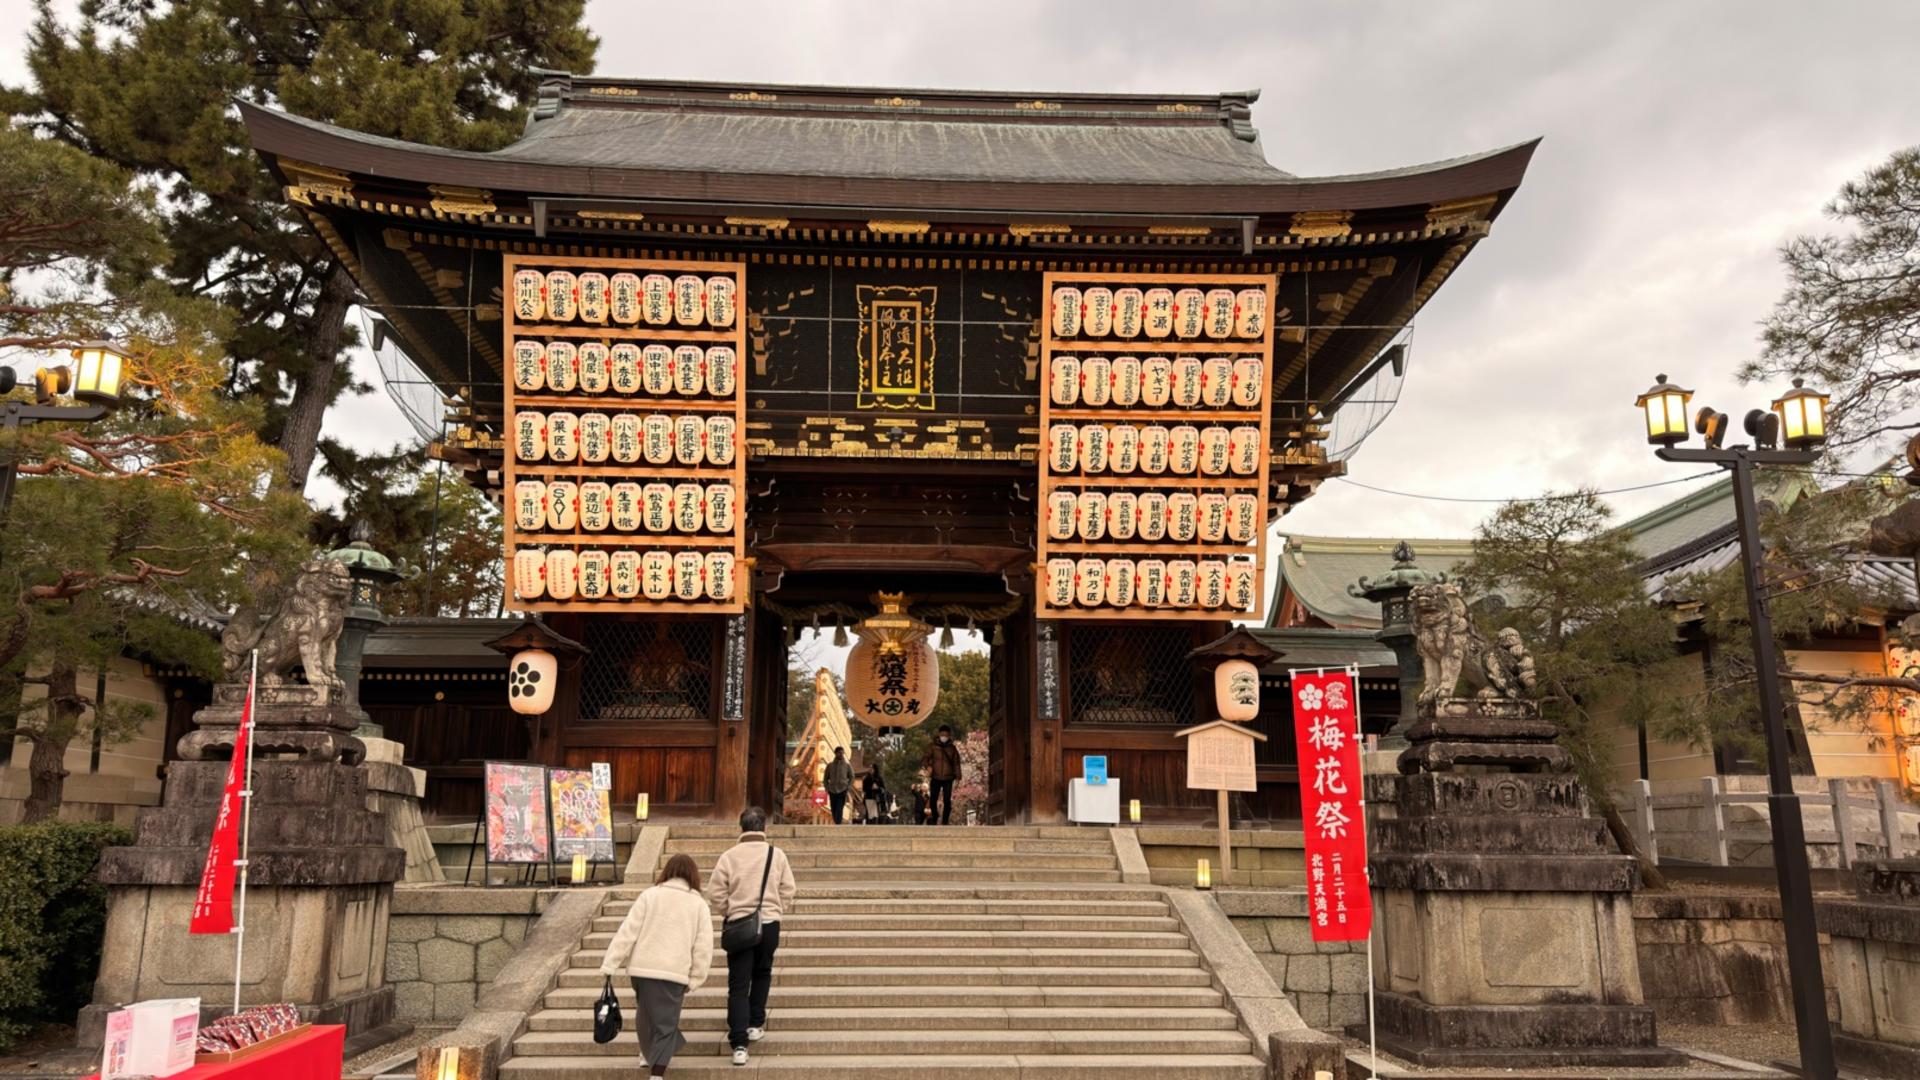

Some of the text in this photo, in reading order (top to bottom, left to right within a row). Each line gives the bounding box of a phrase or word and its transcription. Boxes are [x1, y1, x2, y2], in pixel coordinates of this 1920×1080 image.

[1245, 314, 1260, 334] 老松
[1152, 366, 1164, 401] ヤギコー
[1245, 383, 1256, 401] もり
[1086, 568, 1100, 601] 和乃匠
[1308, 715, 1351, 840] 梅花祭
[1311, 853, 1329, 927] 北野天満宮
[1331, 853, 1347, 924] 二月二十五日
